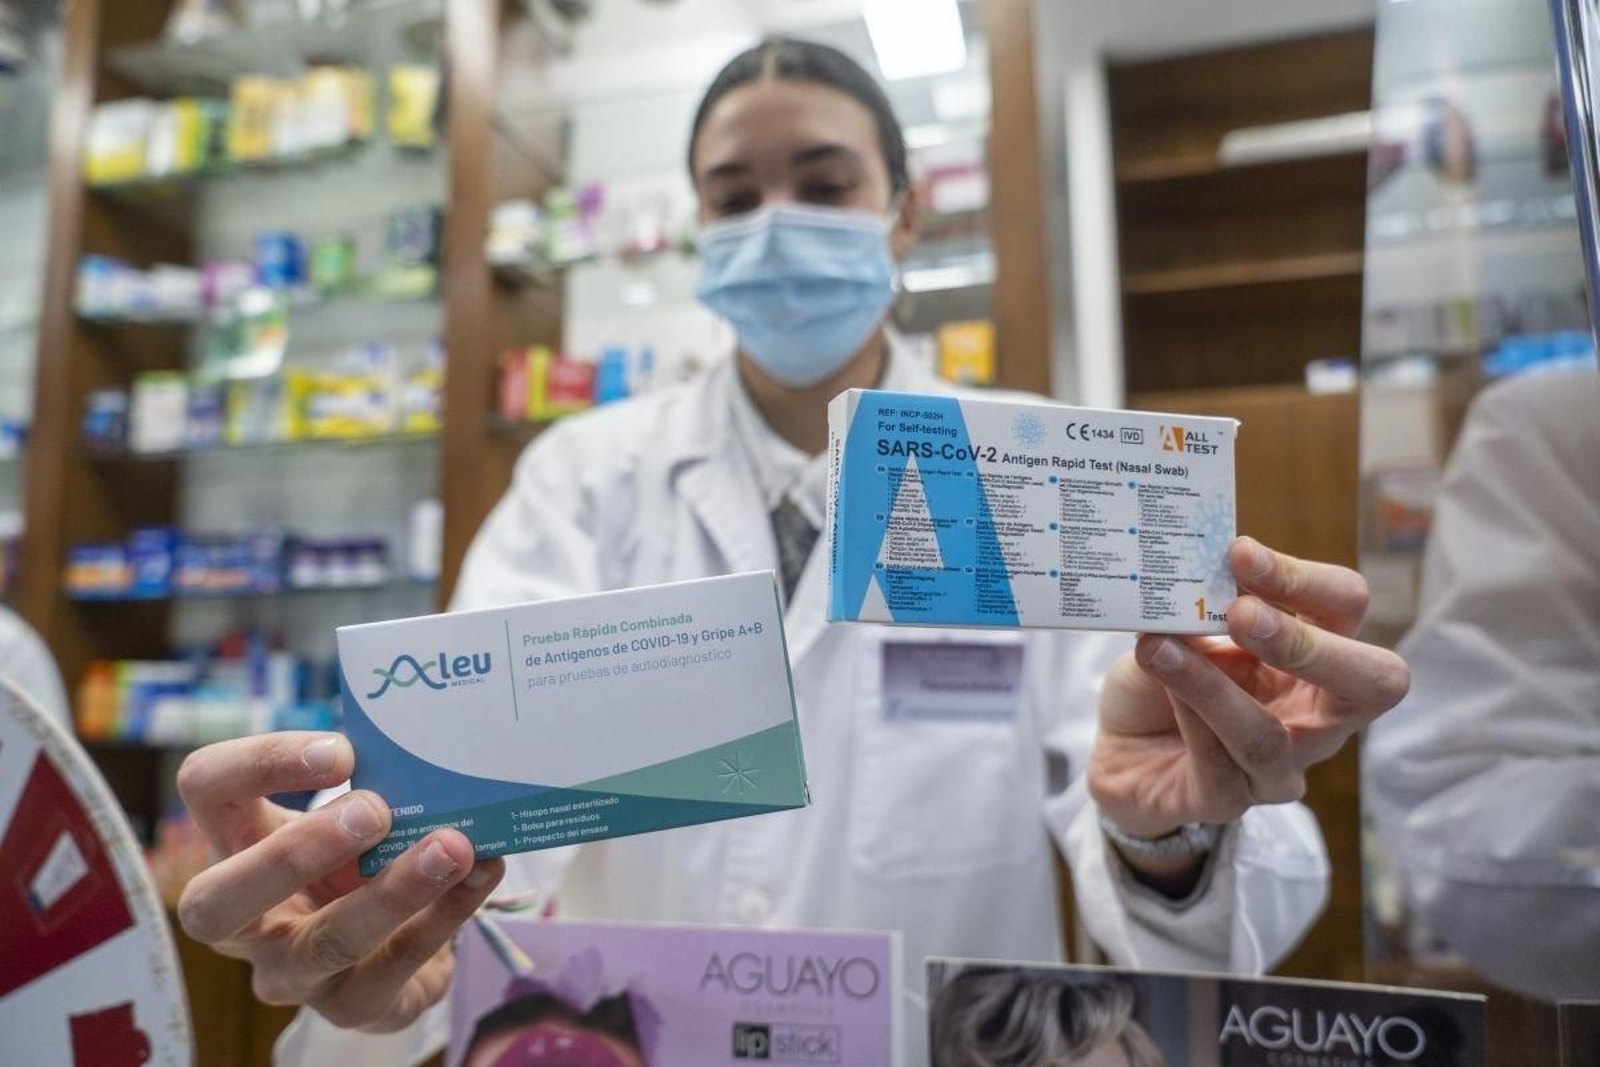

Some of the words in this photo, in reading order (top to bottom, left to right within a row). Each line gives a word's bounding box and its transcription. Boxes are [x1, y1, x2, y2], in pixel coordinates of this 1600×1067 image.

[878, 408, 898, 417] REF:
[878, 421, 896, 431] For
[899, 422, 958, 438] Self-testing
[1092, 429, 1115, 439] 1434
[1185, 431, 1209, 443] ALL
[877, 438, 998, 463] SARS-CoV-2
[1001, 453, 1049, 468] Antigen
[1051, 456, 1086, 470] Rapid
[1089, 459, 1114, 471] Test
[1116, 461, 1152, 474] (Nasal
[1154, 464, 1189, 479] Swab)
[1185, 443, 1219, 455] TEST
[1195, 597, 1205, 620] 1
[1206, 611, 1228, 622] Test
[522, 630, 570, 646] Prueba
[620, 612, 693, 632] Combinada
[525, 655, 541, 667] de
[612, 642, 628, 655] de
[631, 632, 689, 652] COVID-19
[691, 634, 698, 646] y
[701, 628, 735, 641] Gripe
[738, 621, 764, 637] A+B
[451, 678, 484, 687] MEDICAL
[527, 675, 556, 688] para
[559, 667, 610, 684] pruebas
[612, 664, 628, 676] de
[520, 808, 549, 819] Hisopo
[549, 803, 571, 814] nasal
[572, 797, 620, 811] esterilizado
[407, 826, 418, 835] de
[461, 818, 474, 828] del
[521, 821, 545, 832] Bolsa
[546, 820, 564, 829] para
[565, 813, 600, 825] residuos
[523, 832, 565, 845] Prospecto
[566, 829, 579, 837] del
[580, 825, 609, 835] envase
[698, 952, 880, 999] AGUAYO
[1218, 1003, 1426, 1061] AGUAYO
